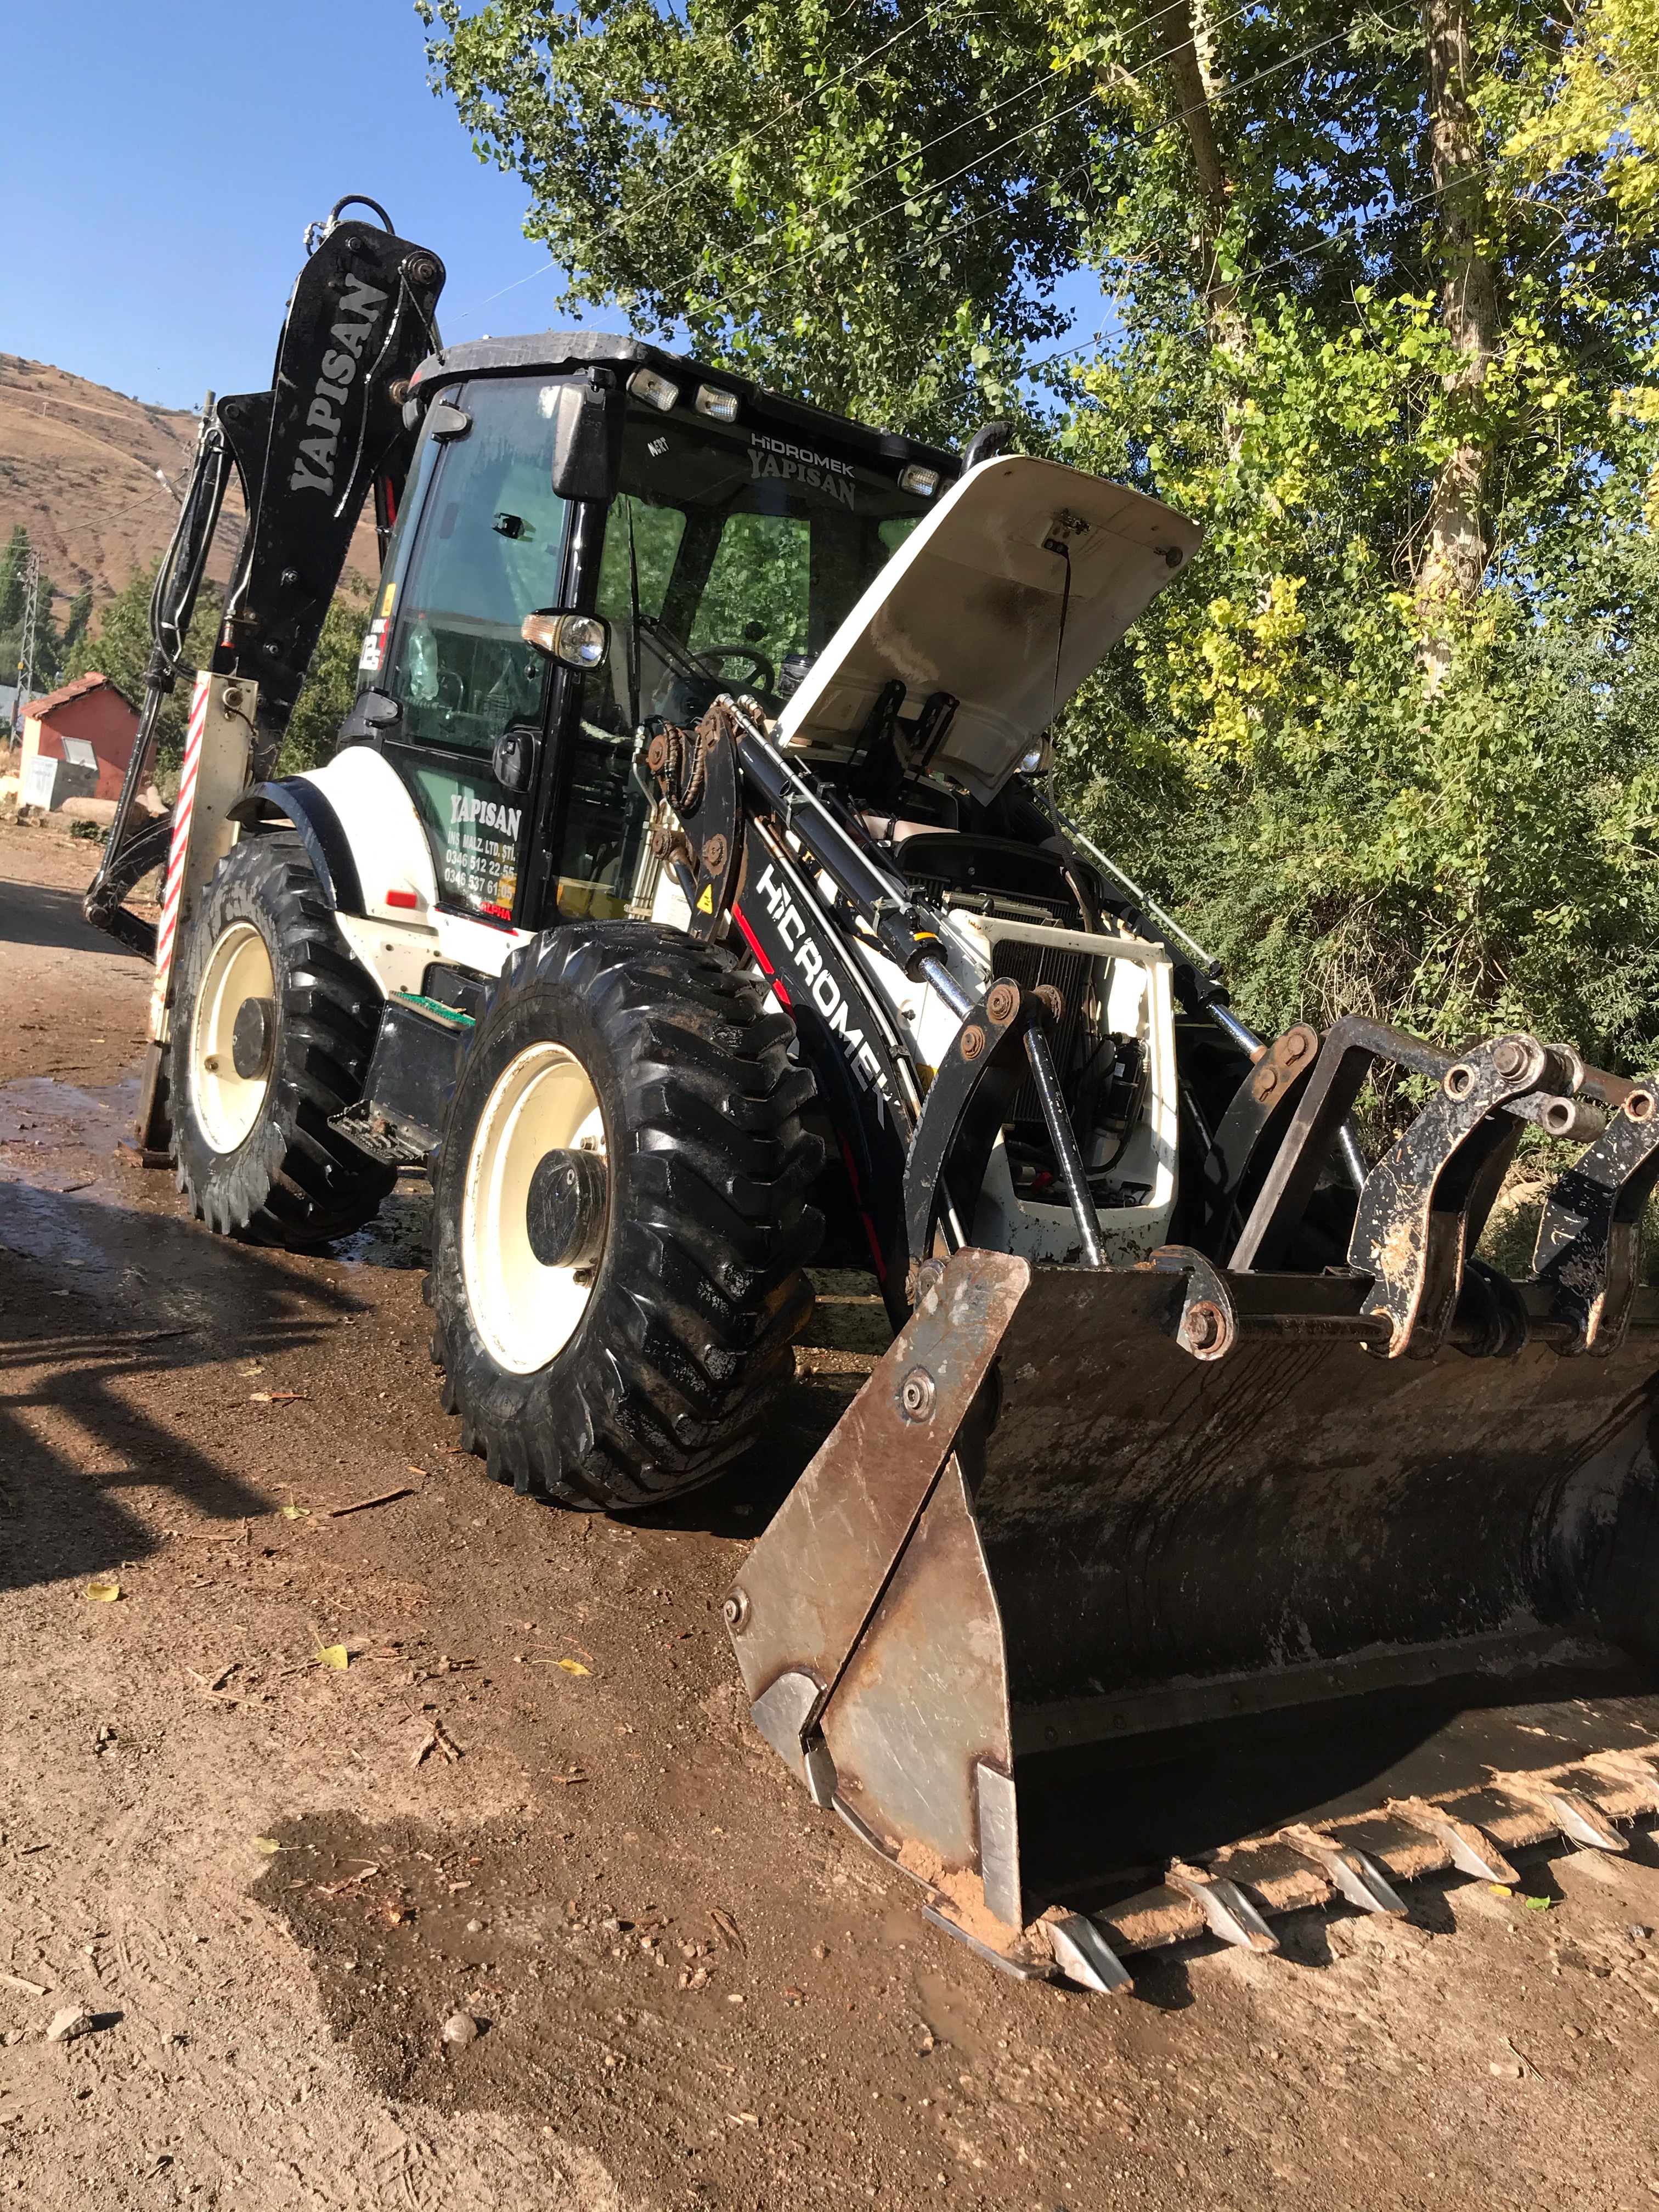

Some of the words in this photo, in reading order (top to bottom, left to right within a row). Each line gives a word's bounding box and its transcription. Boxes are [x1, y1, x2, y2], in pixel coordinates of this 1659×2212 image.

[290, 273, 388, 496] YAPISAN
[747, 448, 855, 511] YAPISAN
[451, 794, 522, 842] YAPISAN
[462, 834, 483, 853] MALZ.
[485, 839, 500, 857] LTD.
[446, 849, 467, 867] 0346
[470, 855, 487, 872] 512
[489, 861, 500, 877] 22
[503, 865, 515, 880] 55
[444, 867, 466, 887] 0346
[469, 874, 486, 891] 537
[487, 880, 498, 895] 61
[501, 884, 512, 900] 05
[480, 901, 511, 921] ALPHA
